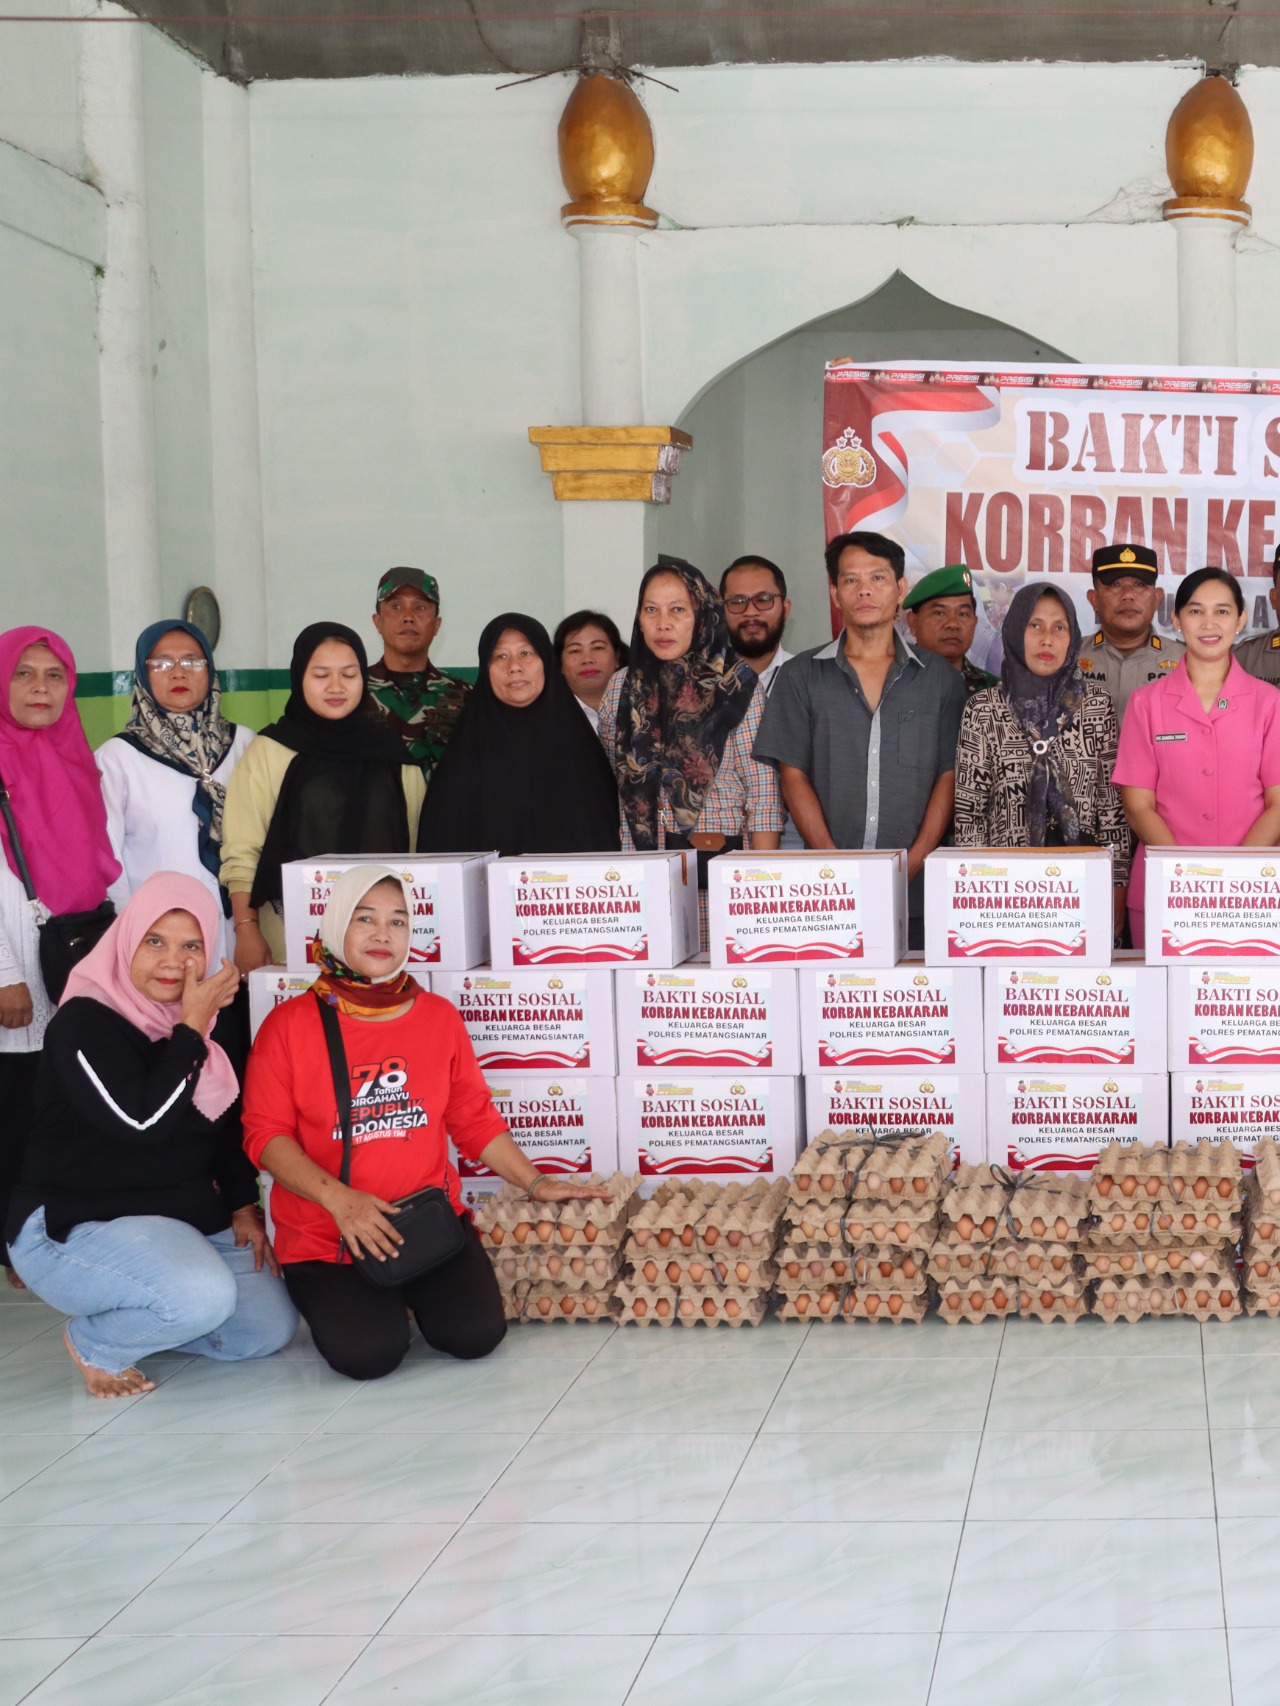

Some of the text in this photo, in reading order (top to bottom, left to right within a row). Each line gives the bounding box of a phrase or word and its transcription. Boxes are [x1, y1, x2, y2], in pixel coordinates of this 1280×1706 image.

[836, 370, 870, 378] PRESISI
[891, 372, 926, 380] PRESISI
[946, 374, 980, 382] PRESISI
[1000, 376, 1034, 384] PRESISI
[1054, 378, 1088, 386] PRESISI
[1109, 379, 1144, 387] PRESISI
[1164, 380, 1198, 388] PRESISI
[1218, 382, 1252, 390] PRESISI
[1026, 410, 1238, 476] BAKTI
[944, 491, 1188, 576] KORBAN
[516, 884, 638, 901] BAKTI SOSIAL
[955, 880, 1078, 893] BAKTI SOSIAL
[515, 900, 641, 917] KORBAN KEBAKARAN
[953, 896, 1080, 909] KORBAN KEBAKARAN
[543, 916, 619, 926] KELUARGA BESAR
[997, 921, 1080, 929] PEMATANGSIANTAR
[559, 925, 642, 935] PEMATANGSIANTAR
[643, 991, 765, 1004] BAKTI SOSIAL
[1006, 988, 1128, 1002] BAKTI SOSIAL
[641, 1006, 766, 1020] KORBAN KEBAKARAN
[1003, 1004, 1130, 1018] KORBAN KEBAKARAN
[352, 1056, 408, 1098] 78
[374, 1086, 403, 1096] Tahun
[350, 1092, 410, 1107] DIRGAHAYU
[642, 1099, 763, 1113] BAKTI SOSIAL
[336, 1099, 424, 1124] EPUBLIK
[641, 1114, 766, 1128] KORBAN KEBAKARAN
[355, 1136, 363, 1144] 17
[363, 1130, 391, 1142] AGUSTUS
[685, 1138, 767, 1147] PEMATANGSIANTAR
